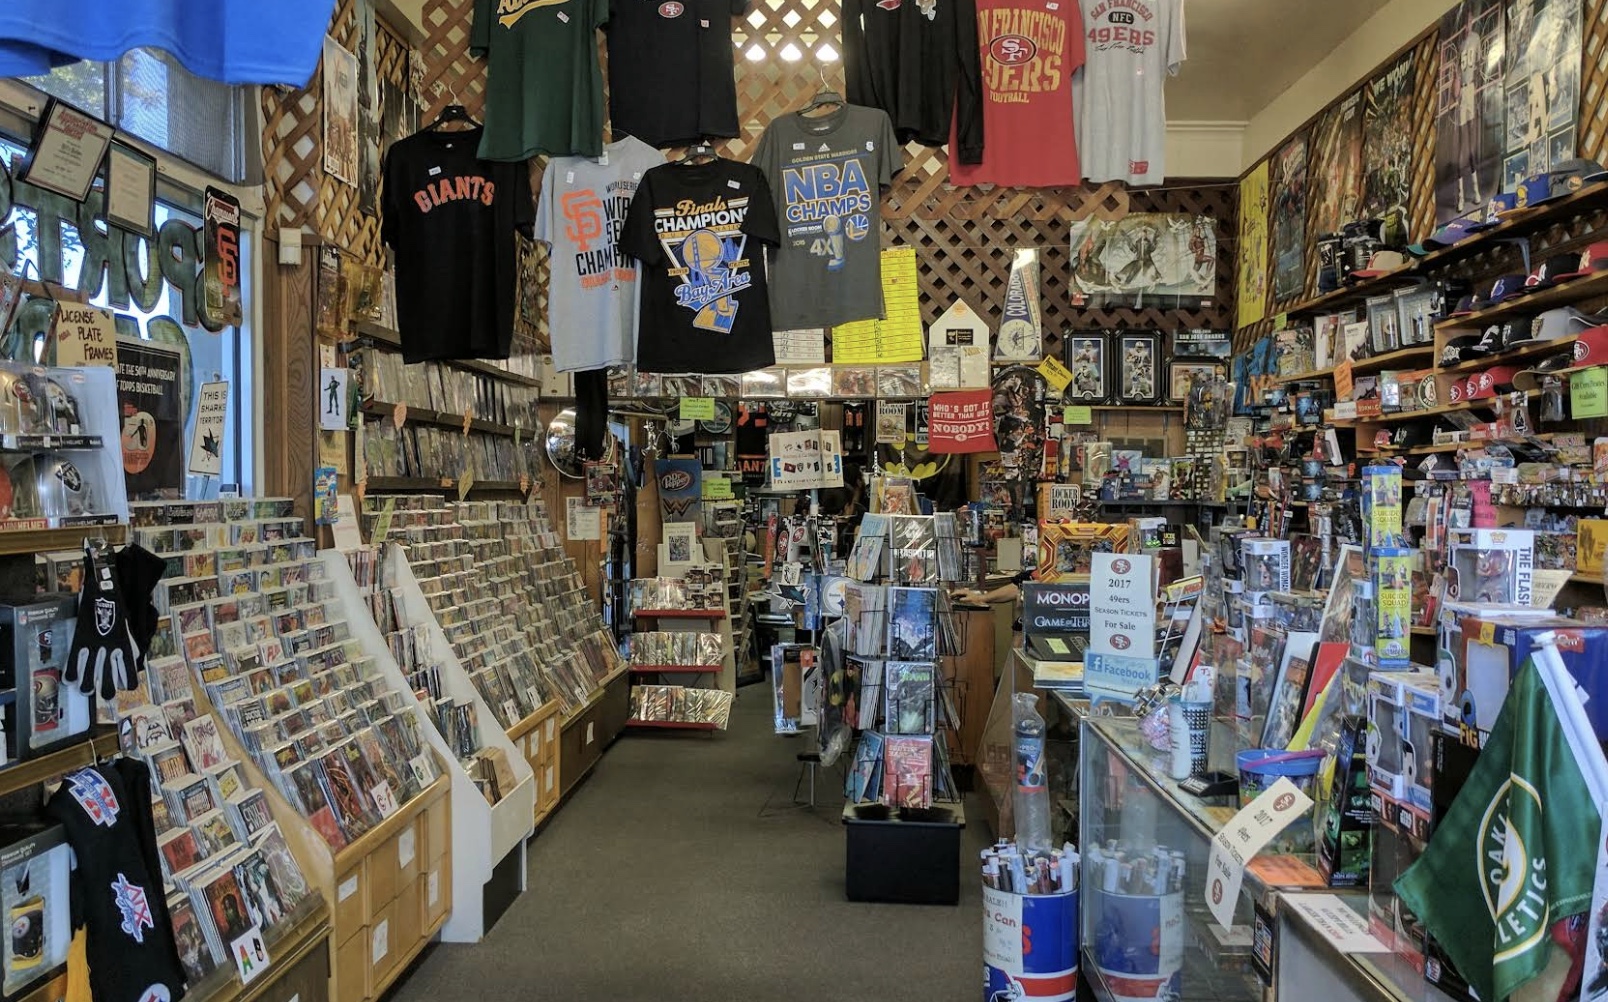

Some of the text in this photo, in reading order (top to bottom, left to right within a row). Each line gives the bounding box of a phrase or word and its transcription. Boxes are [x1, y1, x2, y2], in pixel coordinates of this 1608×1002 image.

[1091, 2, 1107, 21] SAN
[1112, 14, 1132, 22] NFC
[992, 8, 1066, 56] FRANCISCO
[1088, 27, 1155, 46] 49ERS
[985, 54, 1062, 93] 9ERS
[989, 92, 1030, 104] FOOTBALL
[792, 149, 858, 165] GOLDEN STATE WARRIORS
[782, 159, 870, 205] NBA
[414, 176, 495, 213] GIANTS
[676, 195, 727, 217] Finals
[786, 193, 872, 223] CHAMPS
[809, 238, 835, 256] 4X
[709, 270, 751, 293] Area
[674, 283, 714, 304] Bay
[1006, 273, 1028, 317] COLORADO
[60, 309, 95, 324] LICENSE
[78, 326, 103, 343] PLATE
[84, 343, 114, 361] FRAMES
[125, 364, 135, 375] THE
[147, 367, 176, 382] ANNIVERSARY
[204, 390, 219, 400] THIS
[879, 407, 904, 415] ROOM
[933, 403, 959, 413] WHO'S
[963, 404, 979, 413] GOT
[981, 401, 990, 410] IT
[933, 411, 955, 419] BETTER
[932, 421, 990, 434] NOBODY!
[662, 475, 690, 490] Pepper
[671, 473, 681, 482] Dr
[1051, 488, 1078, 500] LOCKER
[1051, 499, 1079, 509] ROOM
[18, 520, 45, 529] HELMET
[1520, 547, 1532, 568] THE
[1108, 579, 1131, 589] 2017
[1036, 593, 1090, 605] MONOP
[1109, 594, 1130, 604] 49ers
[1382, 600, 1408, 608] SQUAD
[1095, 606, 1148, 618] SEASON TICKETS
[1034, 616, 1066, 627] GAME
[1105, 620, 1136, 631] For Sale
[1104, 663, 1151, 681] Facebook
[1237, 828, 1250, 843] 49ers
[1215, 854, 1232, 880] For Sale
[1498, 856, 1547, 944] LETICS
[994, 912, 1016, 928] Can
